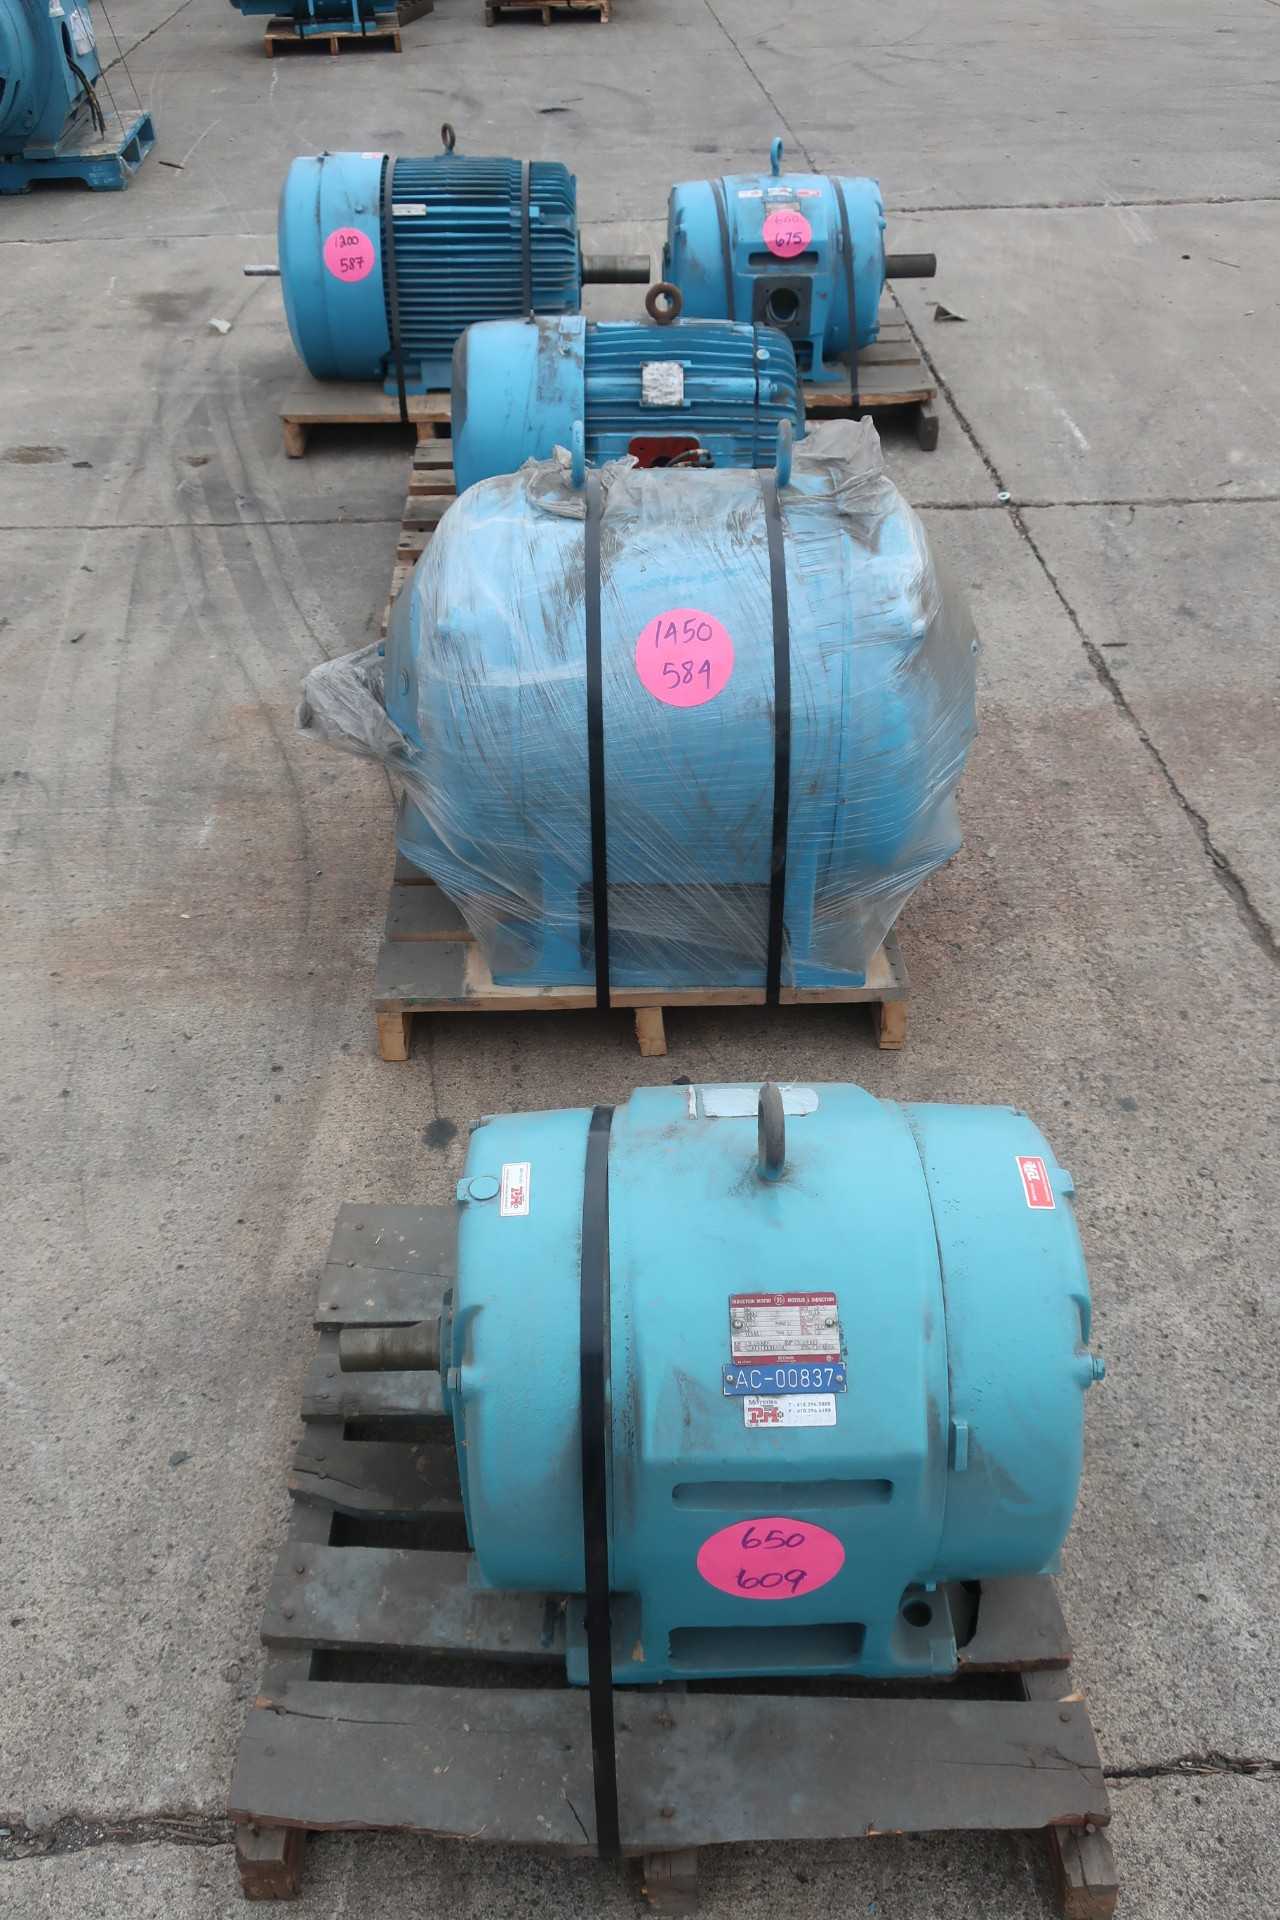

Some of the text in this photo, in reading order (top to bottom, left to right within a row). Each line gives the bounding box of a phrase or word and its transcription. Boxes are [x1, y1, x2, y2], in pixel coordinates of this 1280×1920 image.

[335, 235, 359, 248] 1200
[775, 232, 802, 247] 675
[340, 256, 364, 273] 587
[735, 1367, 834, 1389] AC-00837
[741, 1526, 805, 1550] 650
[736, 1568, 808, 1593] 609
